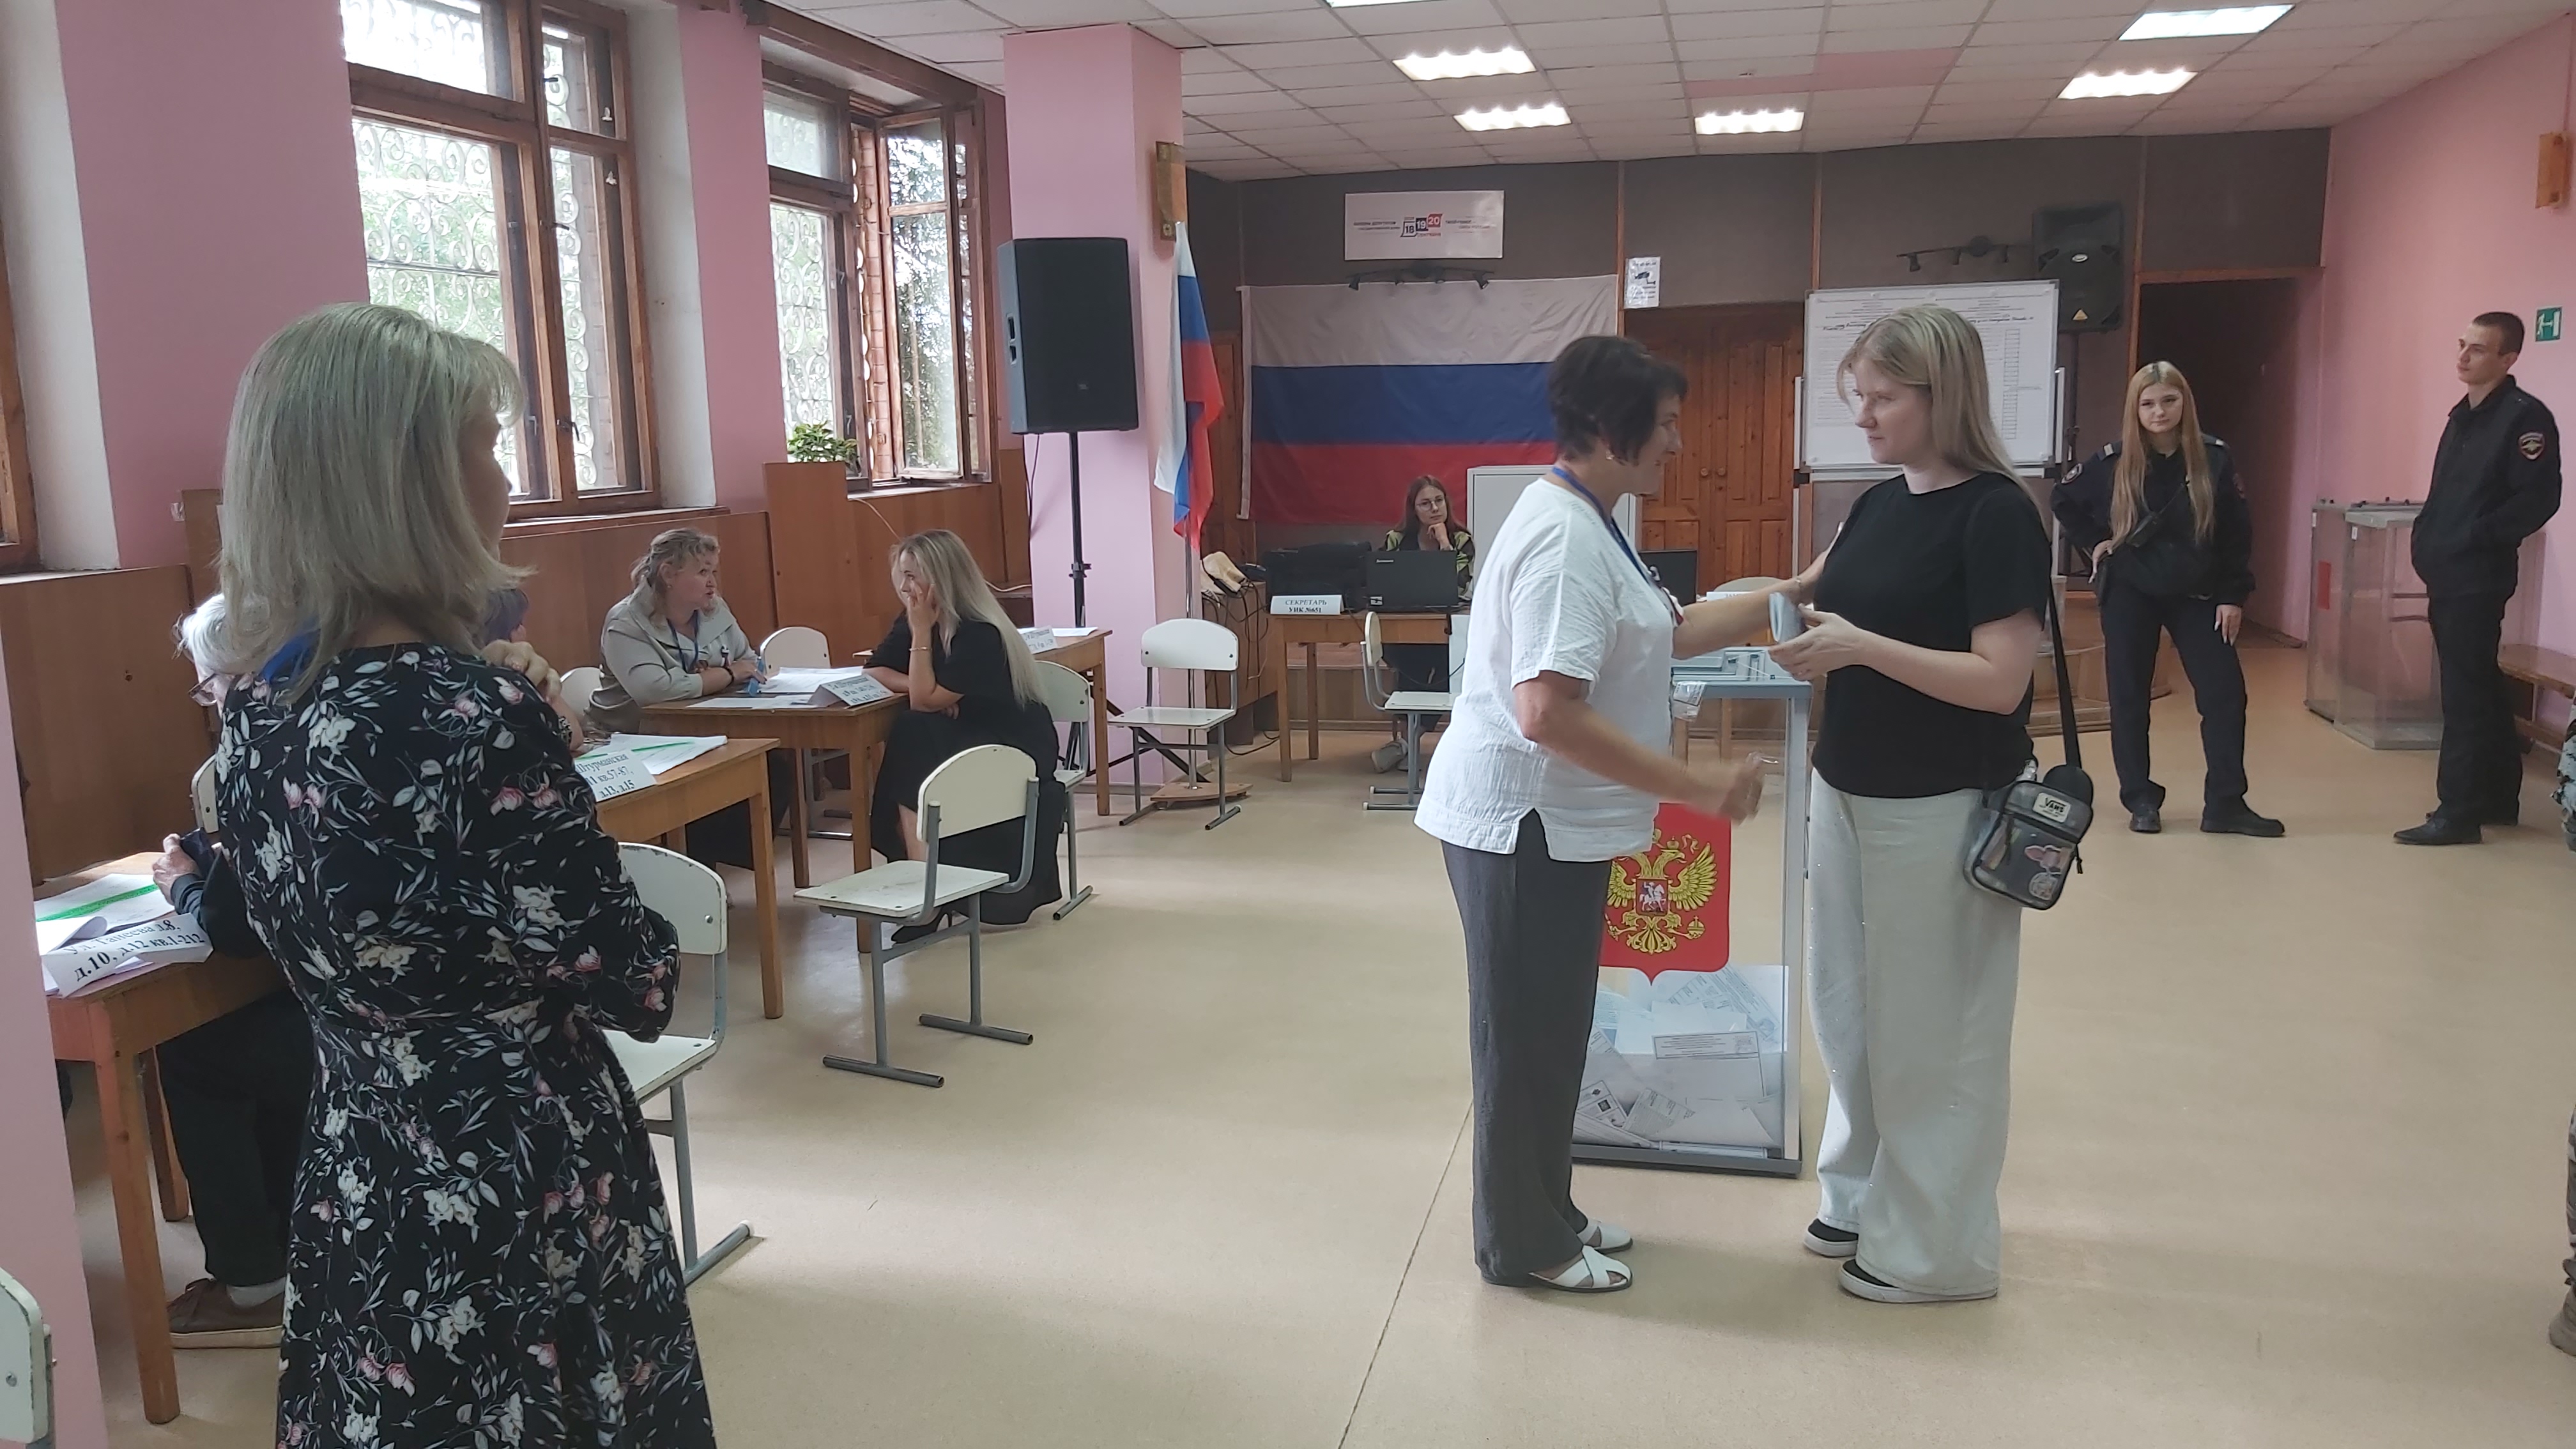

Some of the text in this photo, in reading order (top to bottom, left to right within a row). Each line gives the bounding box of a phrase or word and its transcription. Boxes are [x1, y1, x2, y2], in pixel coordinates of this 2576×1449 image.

[1406, 226, 1414, 234] 18
[1416, 220, 1426, 229] 19
[1428, 217, 1439, 225] 20
[73, 933, 207, 982] д.10, д.12 кв.1-212
